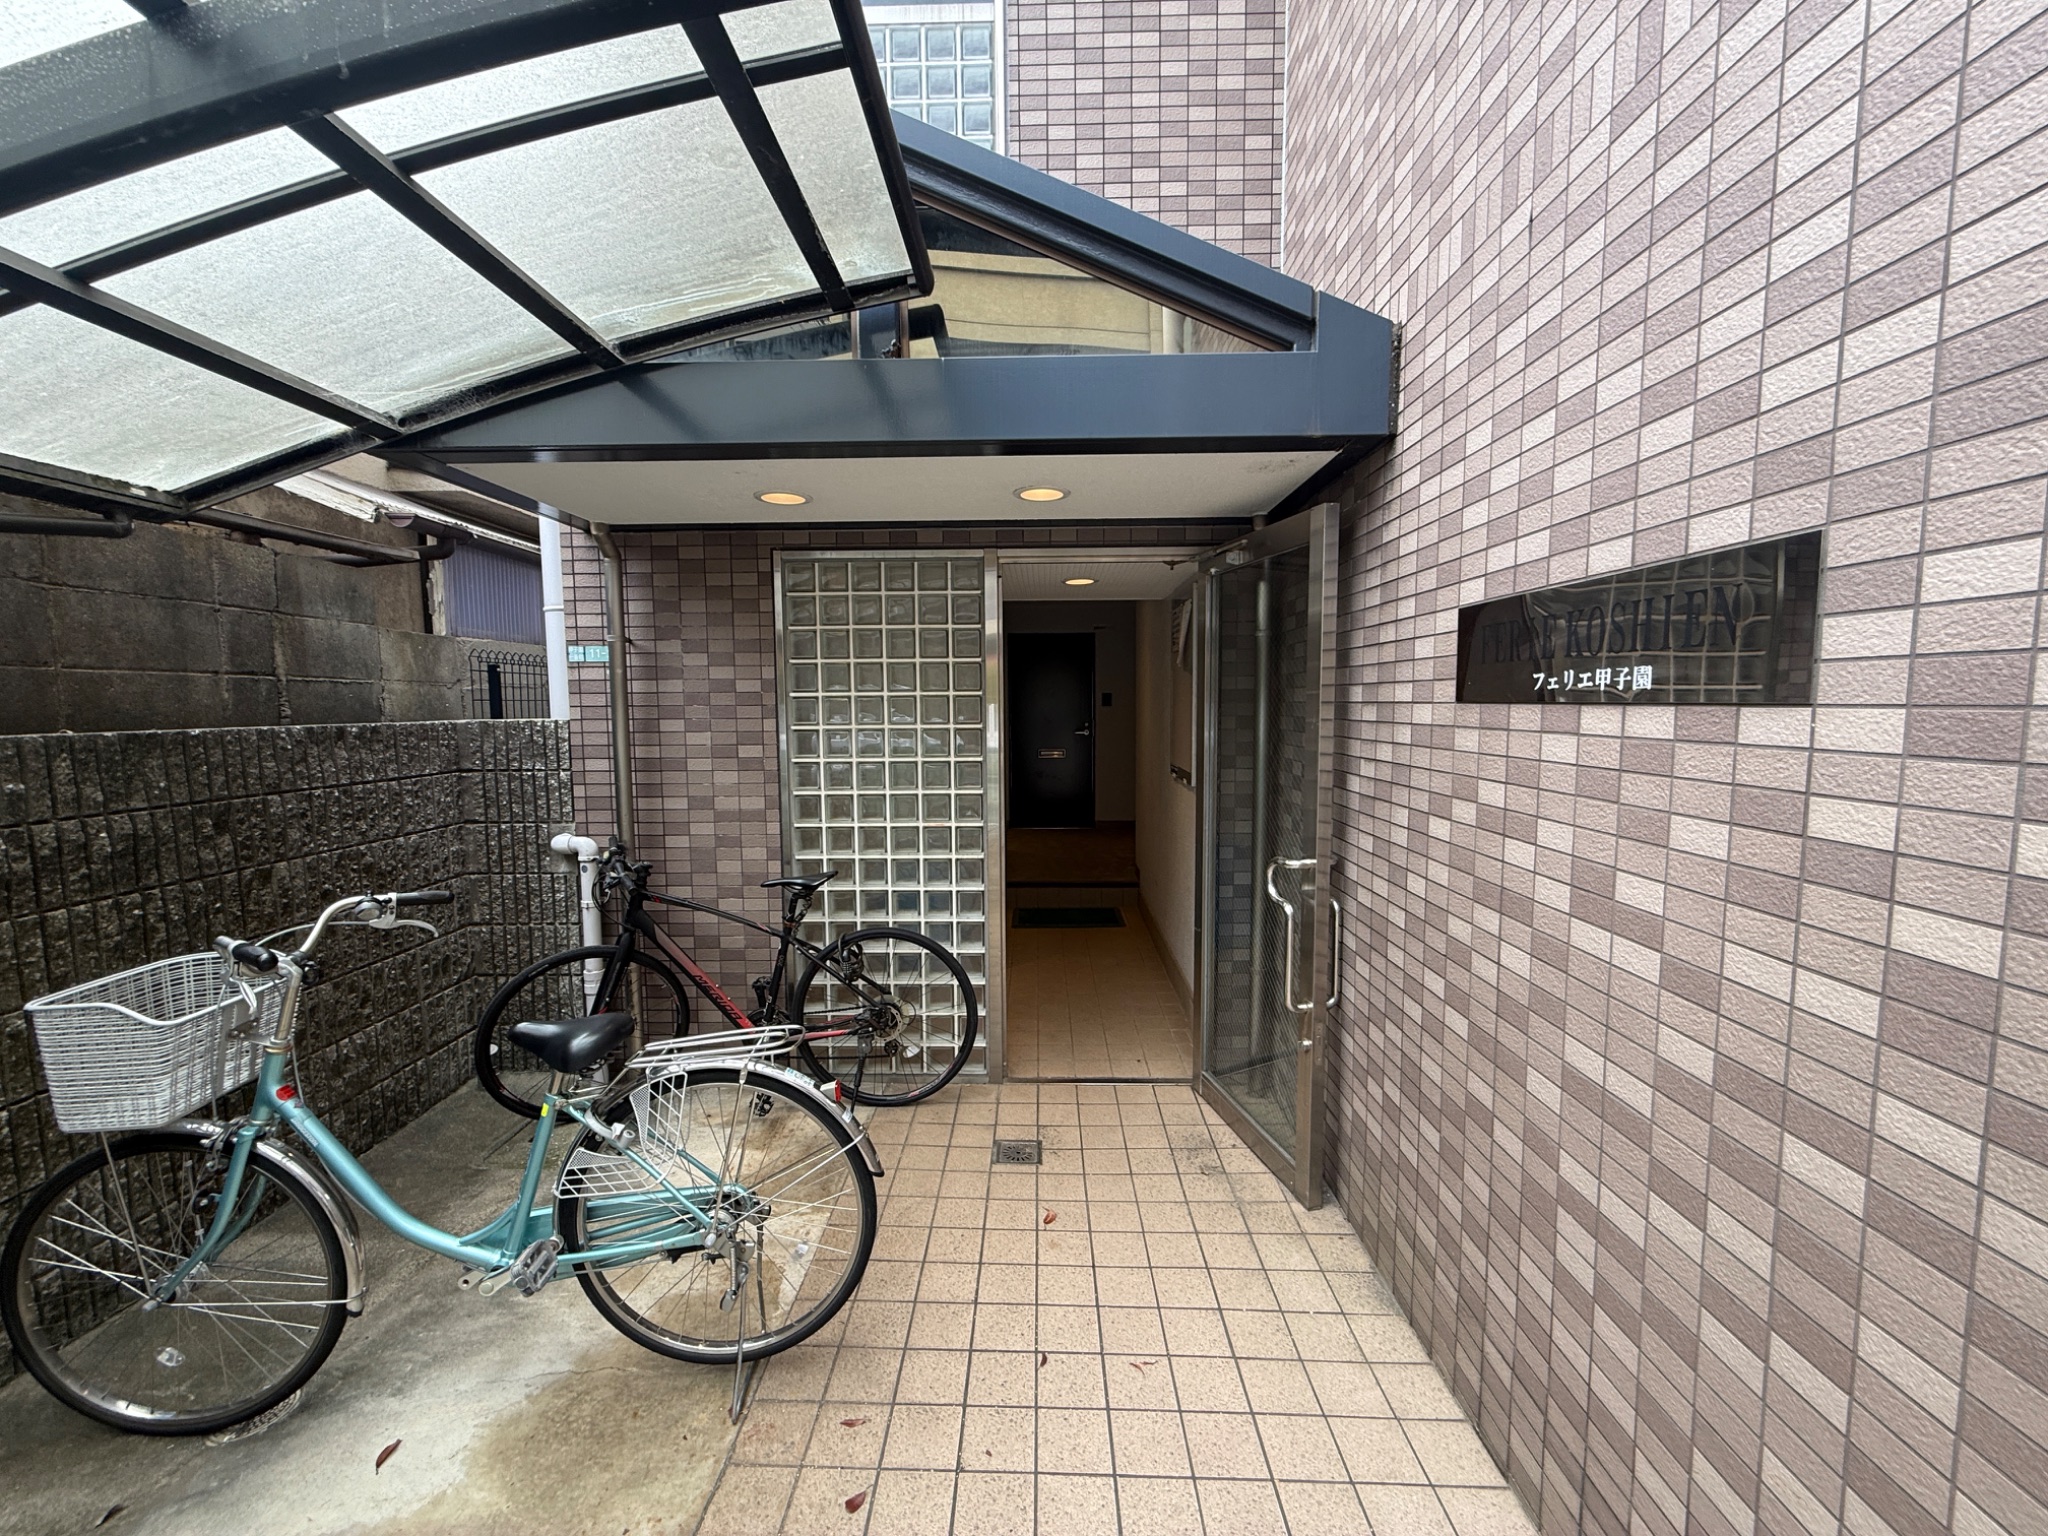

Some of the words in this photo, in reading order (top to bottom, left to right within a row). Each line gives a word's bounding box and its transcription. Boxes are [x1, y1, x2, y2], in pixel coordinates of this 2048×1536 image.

[1481, 614, 1557, 665] FERIE
[1565, 582, 1744, 658] KOSHIEN
[1532, 665, 1653, 691] フェリエ甲子園
[693, 974, 743, 1020] MERIDA
